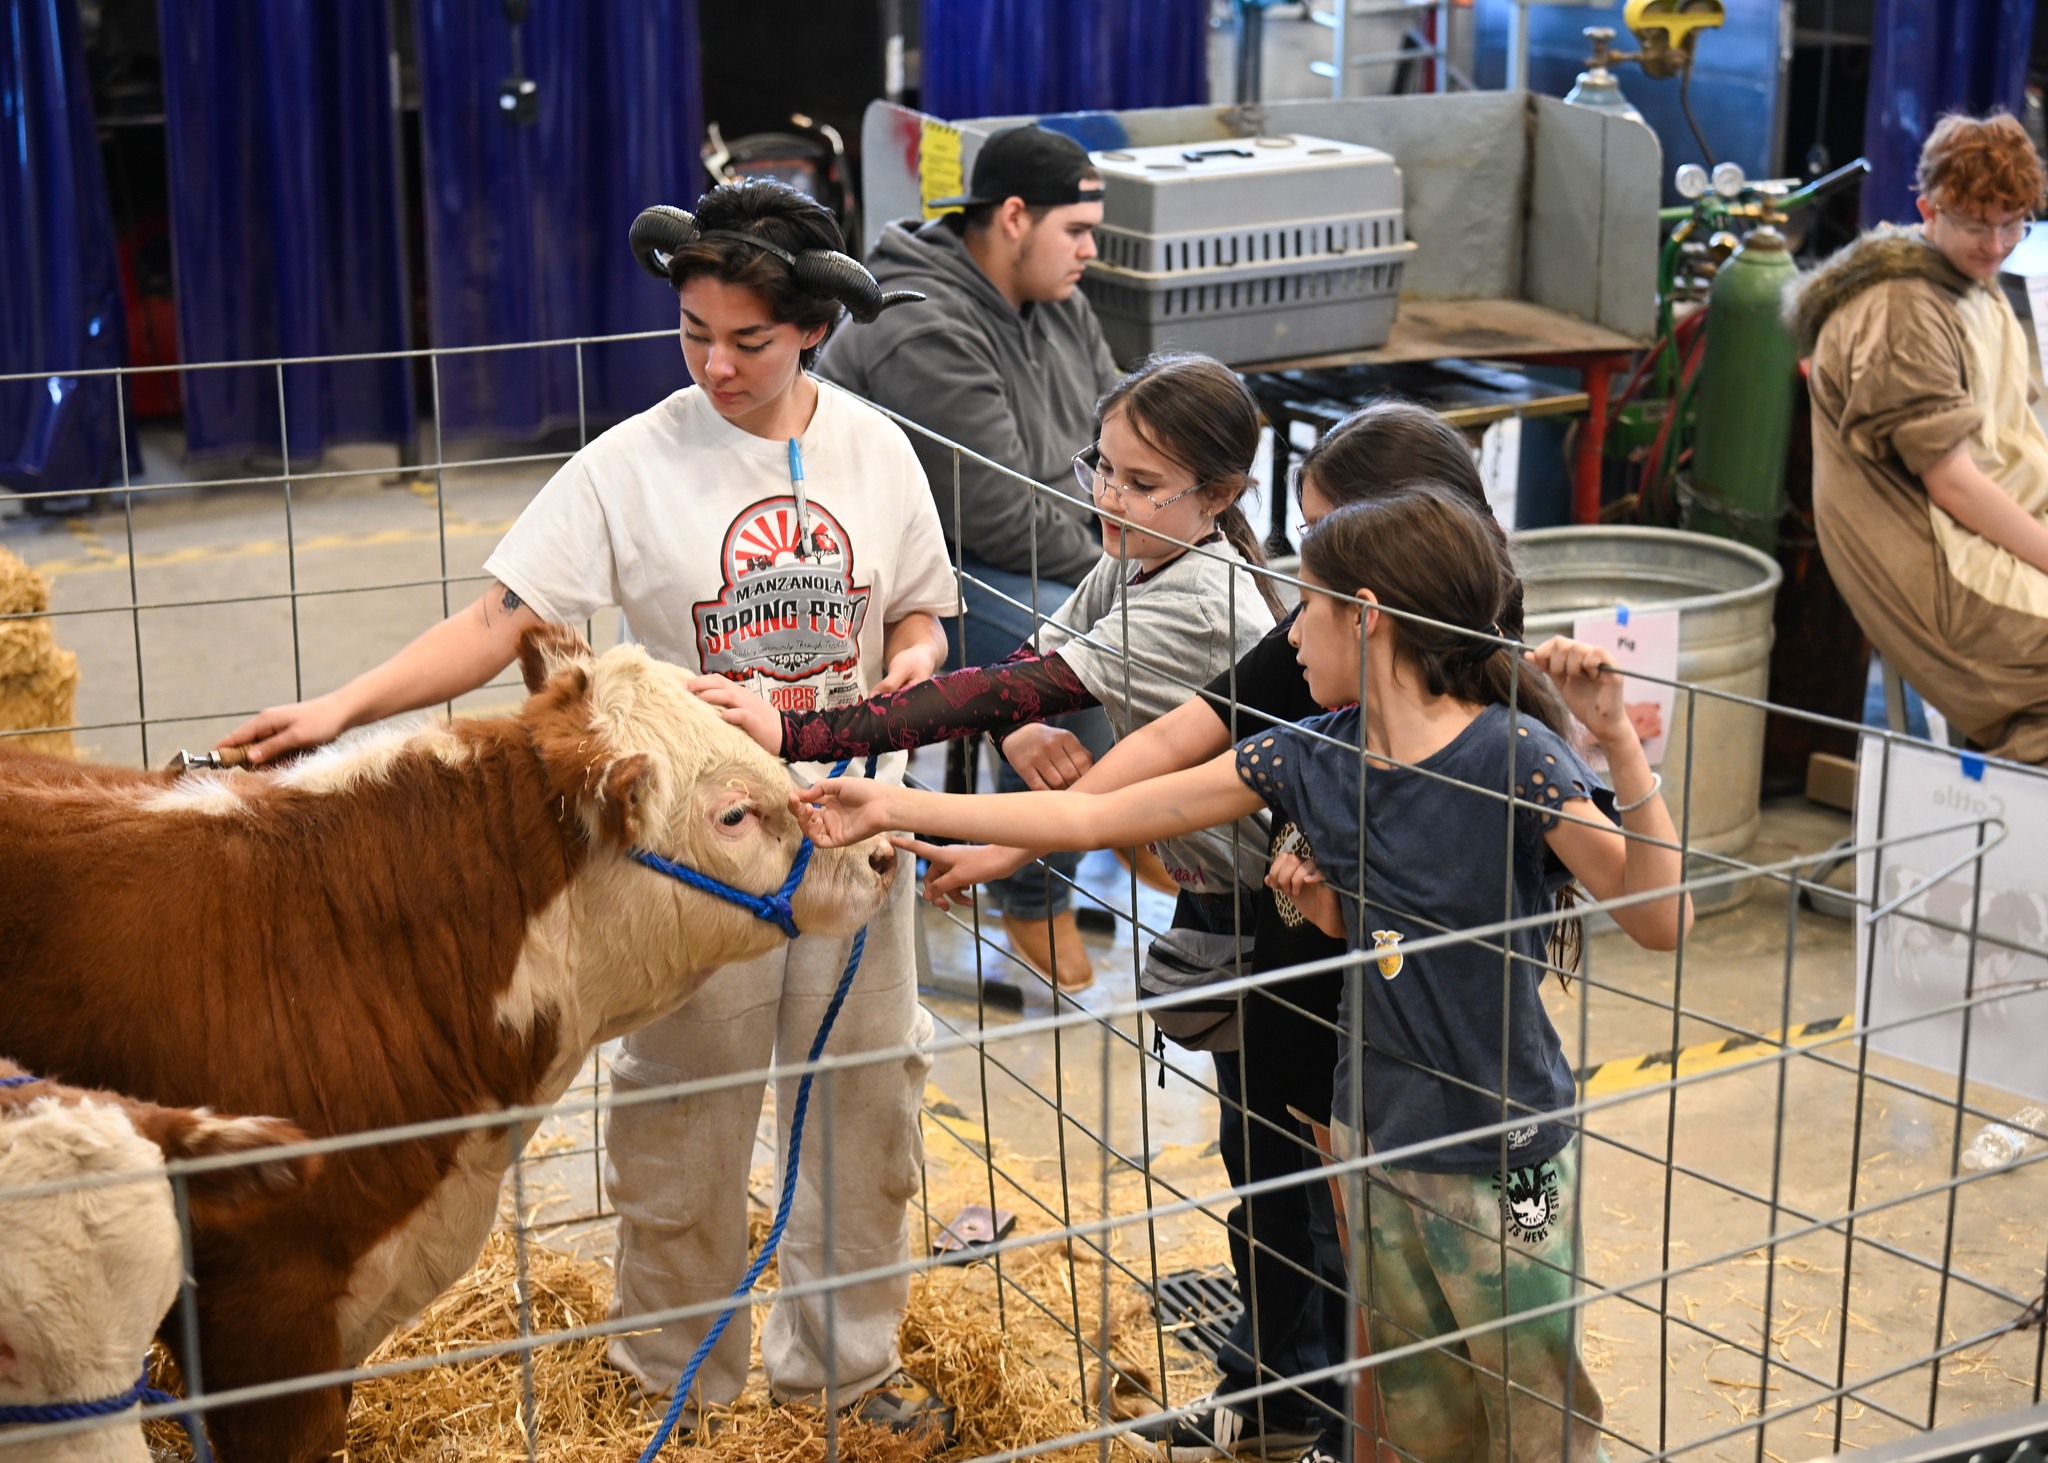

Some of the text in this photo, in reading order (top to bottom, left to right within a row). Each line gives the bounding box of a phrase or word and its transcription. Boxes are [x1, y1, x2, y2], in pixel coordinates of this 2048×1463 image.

[735, 575, 844, 603] MANZANOLA
[705, 599, 798, 654] SPRING
[771, 686, 816, 711] 2025
[1507, 1223, 1522, 1237] IS
[1523, 1226, 1549, 1243] HERE
[1547, 1213, 1558, 1226] TO
